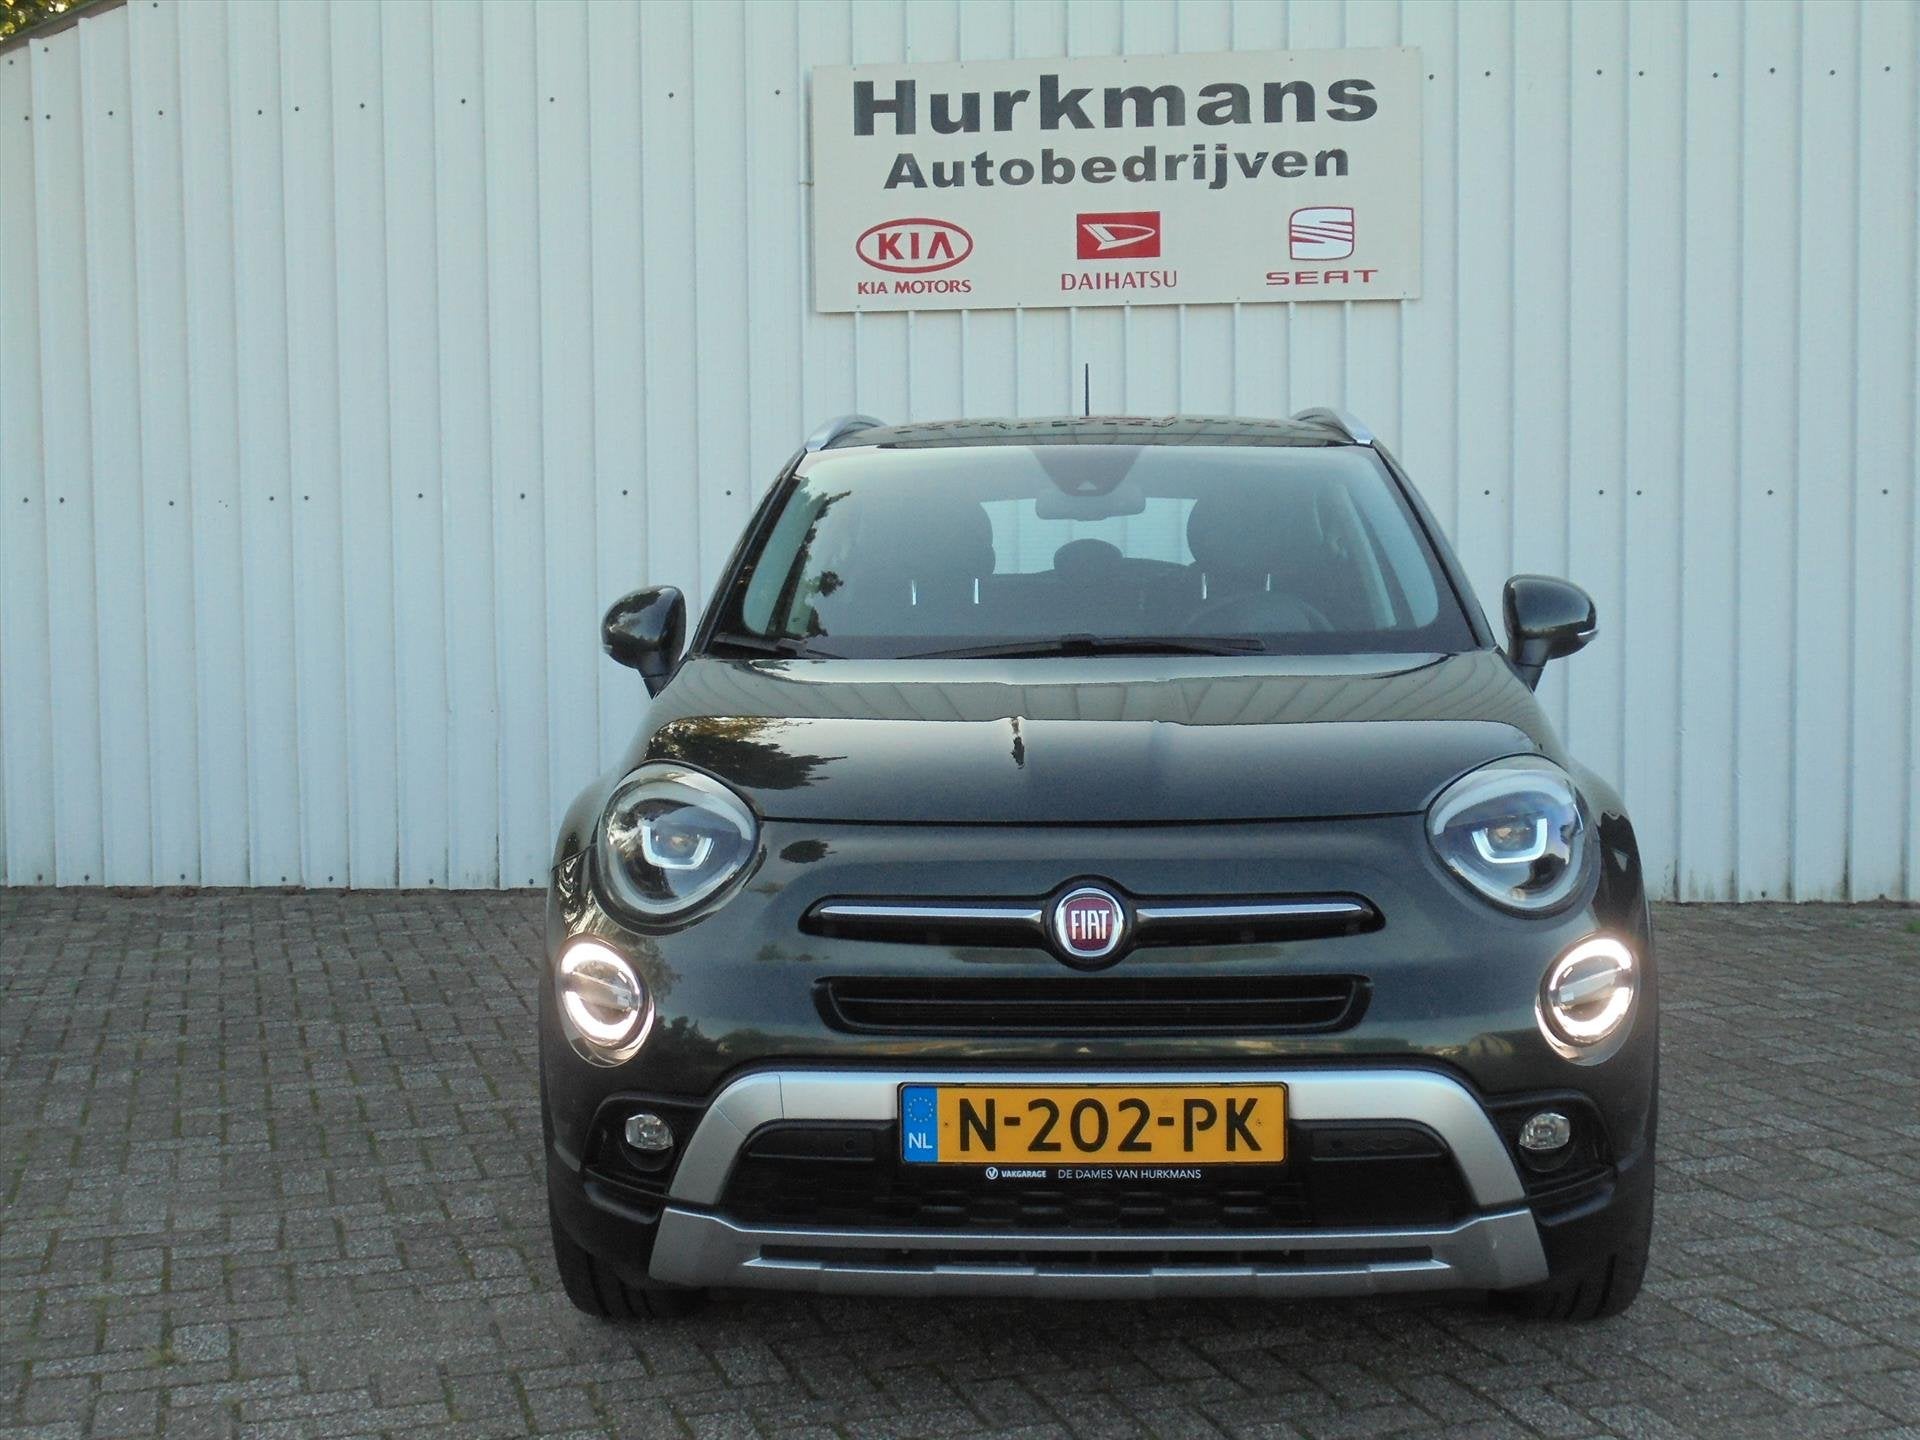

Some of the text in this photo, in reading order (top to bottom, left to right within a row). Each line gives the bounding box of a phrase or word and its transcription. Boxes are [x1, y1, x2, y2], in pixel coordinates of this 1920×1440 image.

[853, 74, 1378, 136] Hurkmans
[884, 143, 1349, 190] Autobedrijven
[877, 231, 955, 260] KIA
[857, 279, 972, 294] KIA MOTORS
[1060, 270, 1178, 291] DAIHATSU
[1265, 269, 1379, 286] SEAT
[1070, 910, 1110, 940] FIAT
[958, 1097, 1263, 1153] N-202-PK
[908, 1132, 933, 1149] NL
[1001, 1169, 1047, 1179] VAKGARAGE
[1057, 1168, 1202, 1180] DE DAMES VAN HURKMANS
